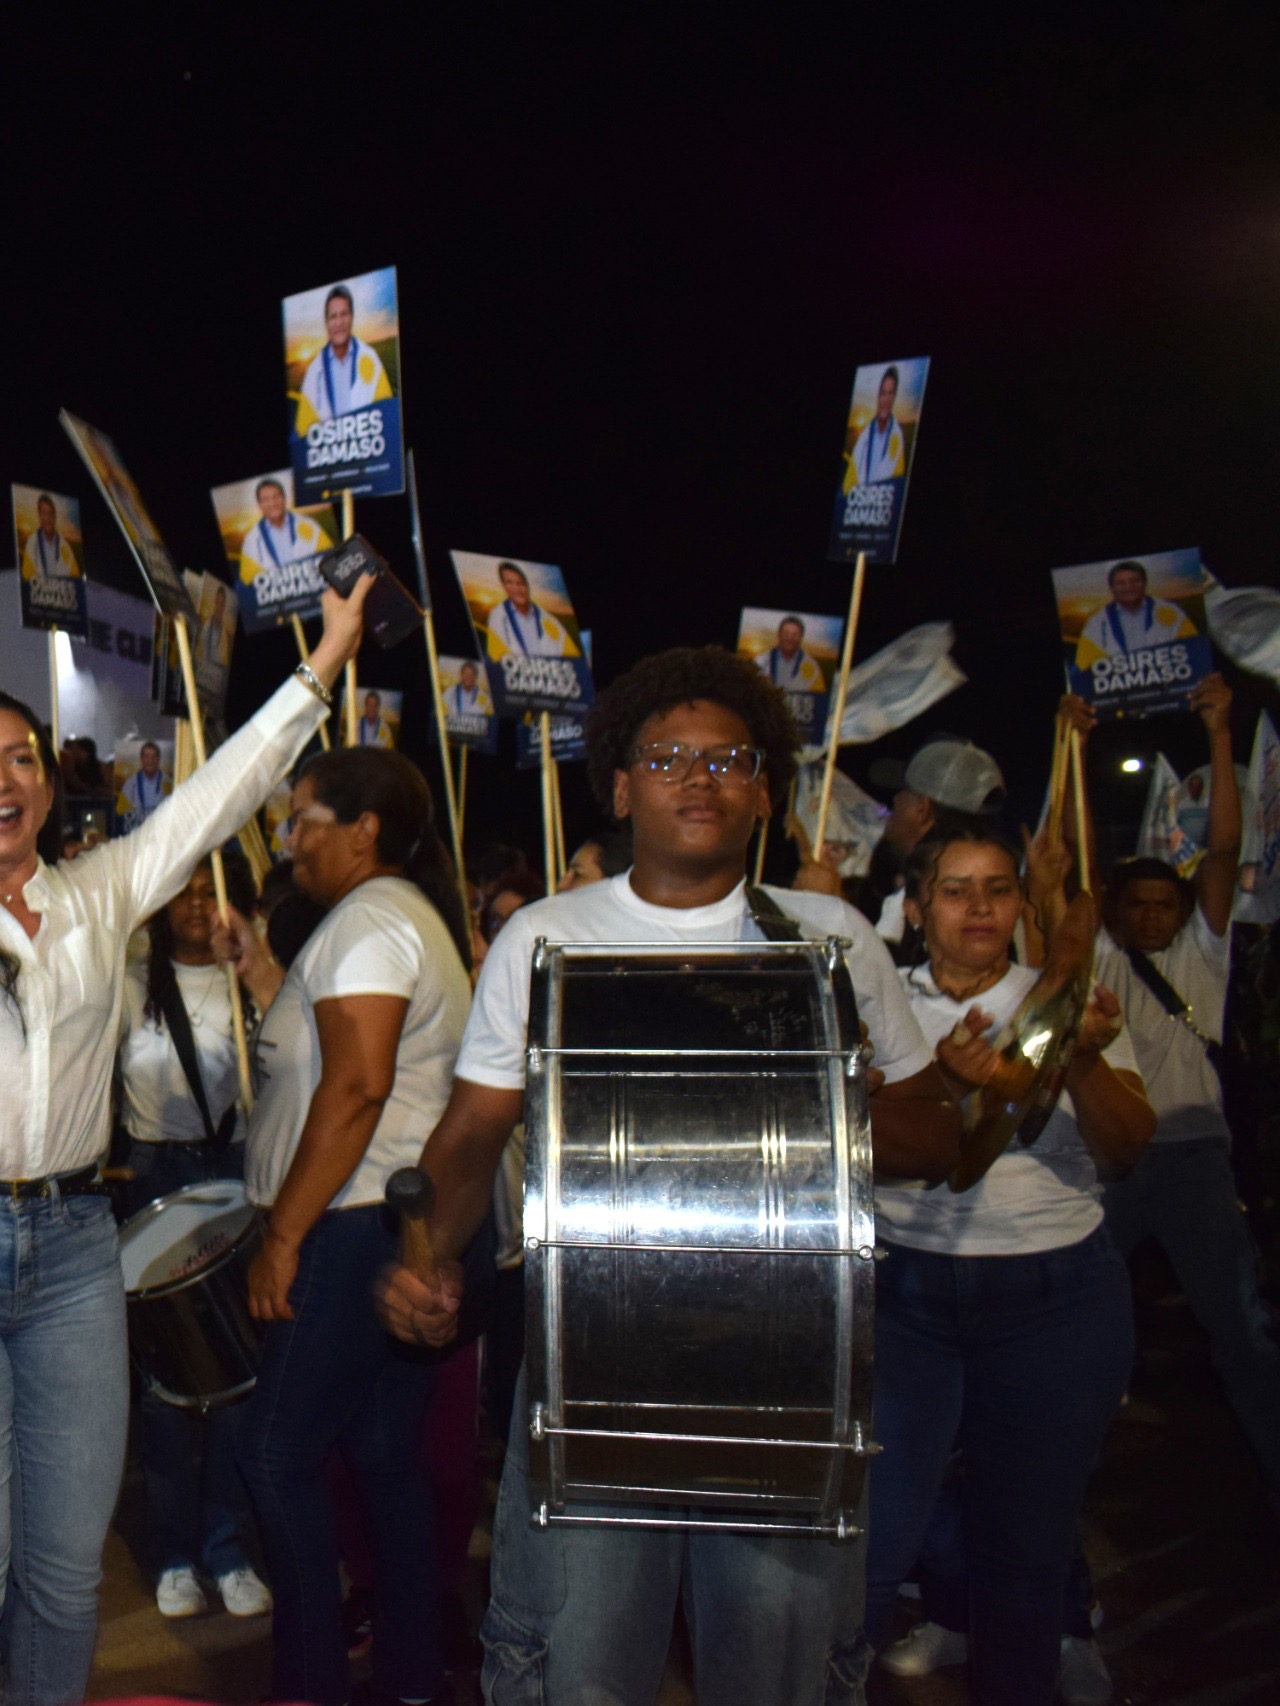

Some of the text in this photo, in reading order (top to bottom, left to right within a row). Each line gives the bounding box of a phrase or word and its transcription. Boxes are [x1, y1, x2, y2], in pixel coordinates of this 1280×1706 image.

[306, 408, 384, 447] OSIRES
[306, 434, 386, 470] DAMASO
[847, 484, 896, 509] OSIRES
[843, 506, 892, 528] DAMASO
[1091, 644, 1189, 677] OSIRES
[1094, 663, 1193, 694] DAMASO
